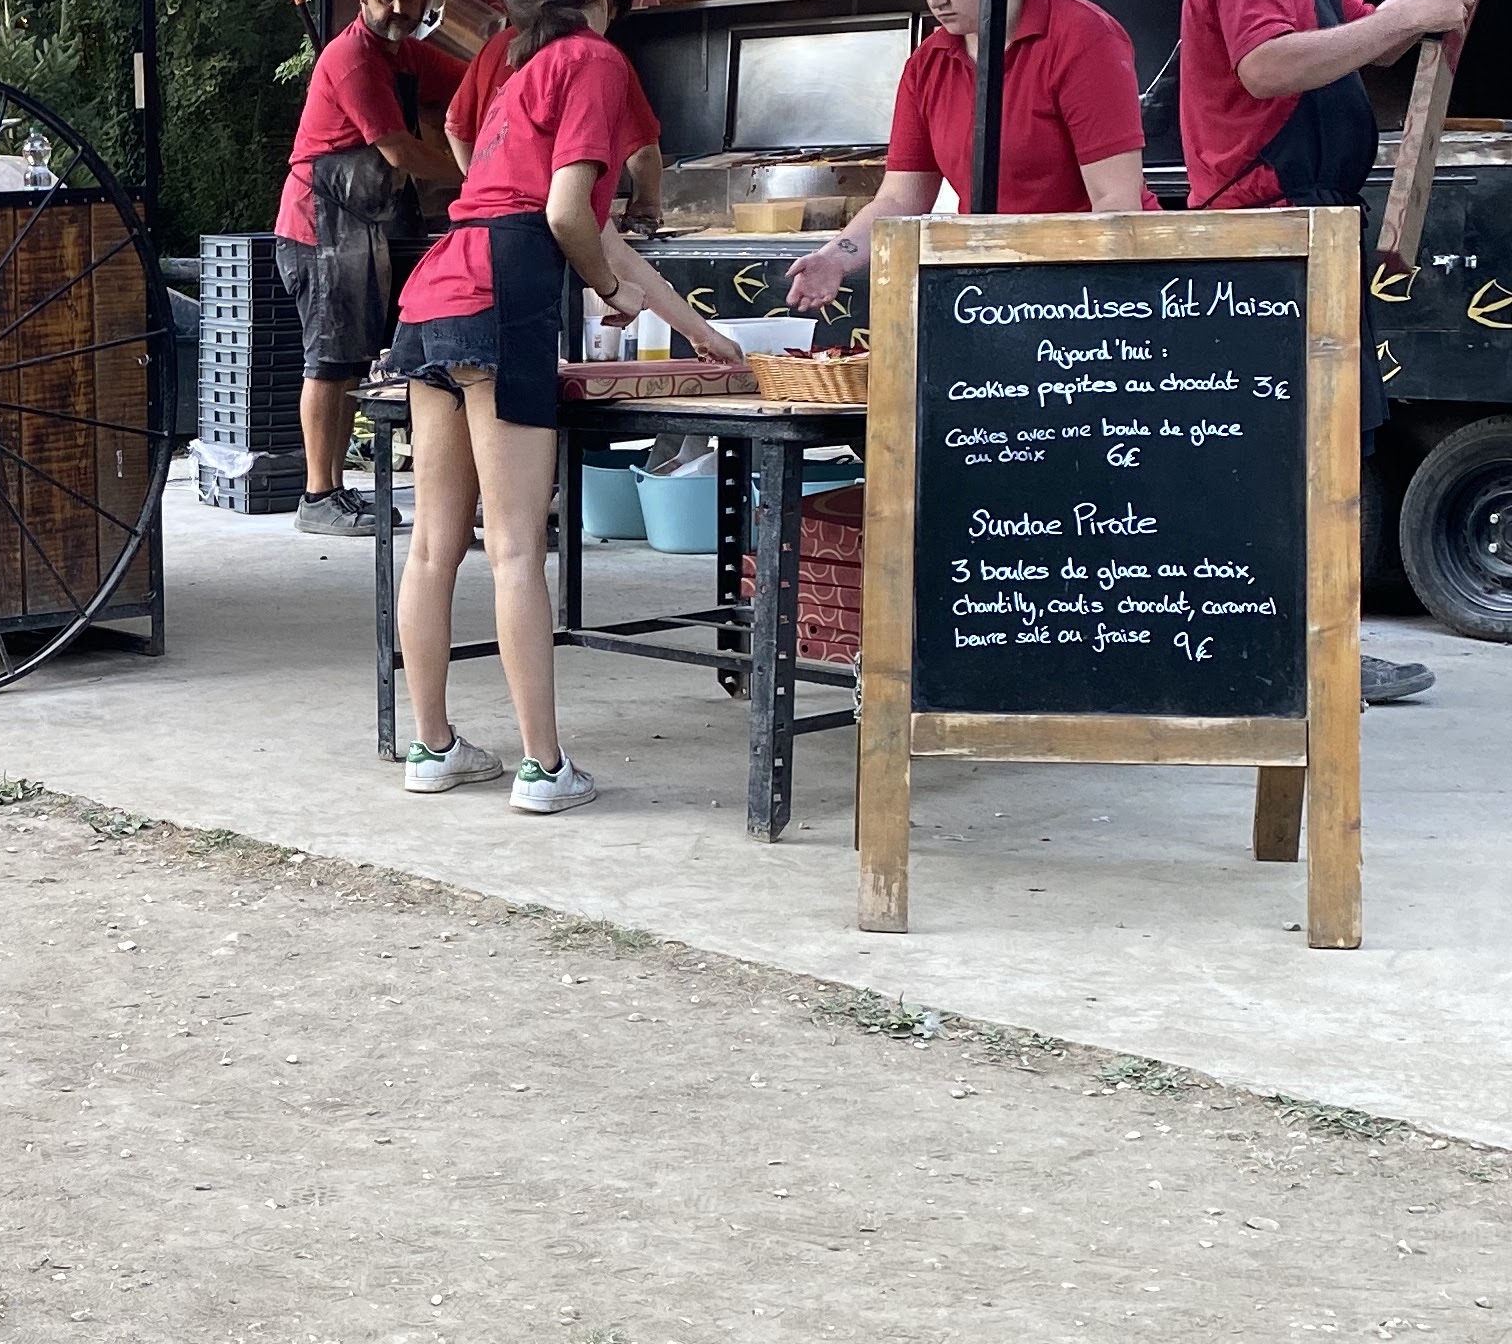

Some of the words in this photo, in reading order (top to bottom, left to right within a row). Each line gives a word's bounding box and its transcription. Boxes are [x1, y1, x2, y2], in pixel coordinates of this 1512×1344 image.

[953, 285, 1153, 327] Gourmandises
[1160, 277, 1201, 320] Fait
[1206, 281, 1301, 318] Maison
[1037, 338, 1153, 370] Aujourd'hui
[948, 380, 1030, 401] Cookies
[1037, 373, 1118, 408] pepites
[1124, 379, 1156, 393] au
[1159, 369, 1240, 391] chocolat
[1252, 376, 1291, 401] 3€
[944, 427, 1010, 450] Cookies
[1016, 428, 1056, 442] avec
[1061, 424, 1092, 438] une
[1101, 417, 1152, 437] boule
[1159, 418, 1185, 437] de
[1189, 419, 1244, 447] glace
[964, 453, 993, 466] au
[997, 445, 1046, 463] choix
[1106, 442, 1141, 468] 6€
[968, 508, 1063, 538] Sundae
[1073, 501, 1158, 536] Pirate
[951, 558, 971, 583] 3
[980, 559, 1050, 581] boules
[1060, 556, 1089, 580] de
[1096, 559, 1152, 591] glace
[1157, 564, 1188, 577] au
[1193, 557, 1256, 585] choix,
[1047, 593, 1105, 615] coulis
[1117, 590, 1196, 623] chocolat,
[1201, 596, 1277, 616] caramel
[954, 627, 1008, 648] beurre
[1014, 624, 1052, 644] salé
[1057, 629, 1083, 644] ou
[1091, 622, 1151, 653] fraise
[1173, 631, 1214, 662] 9€
